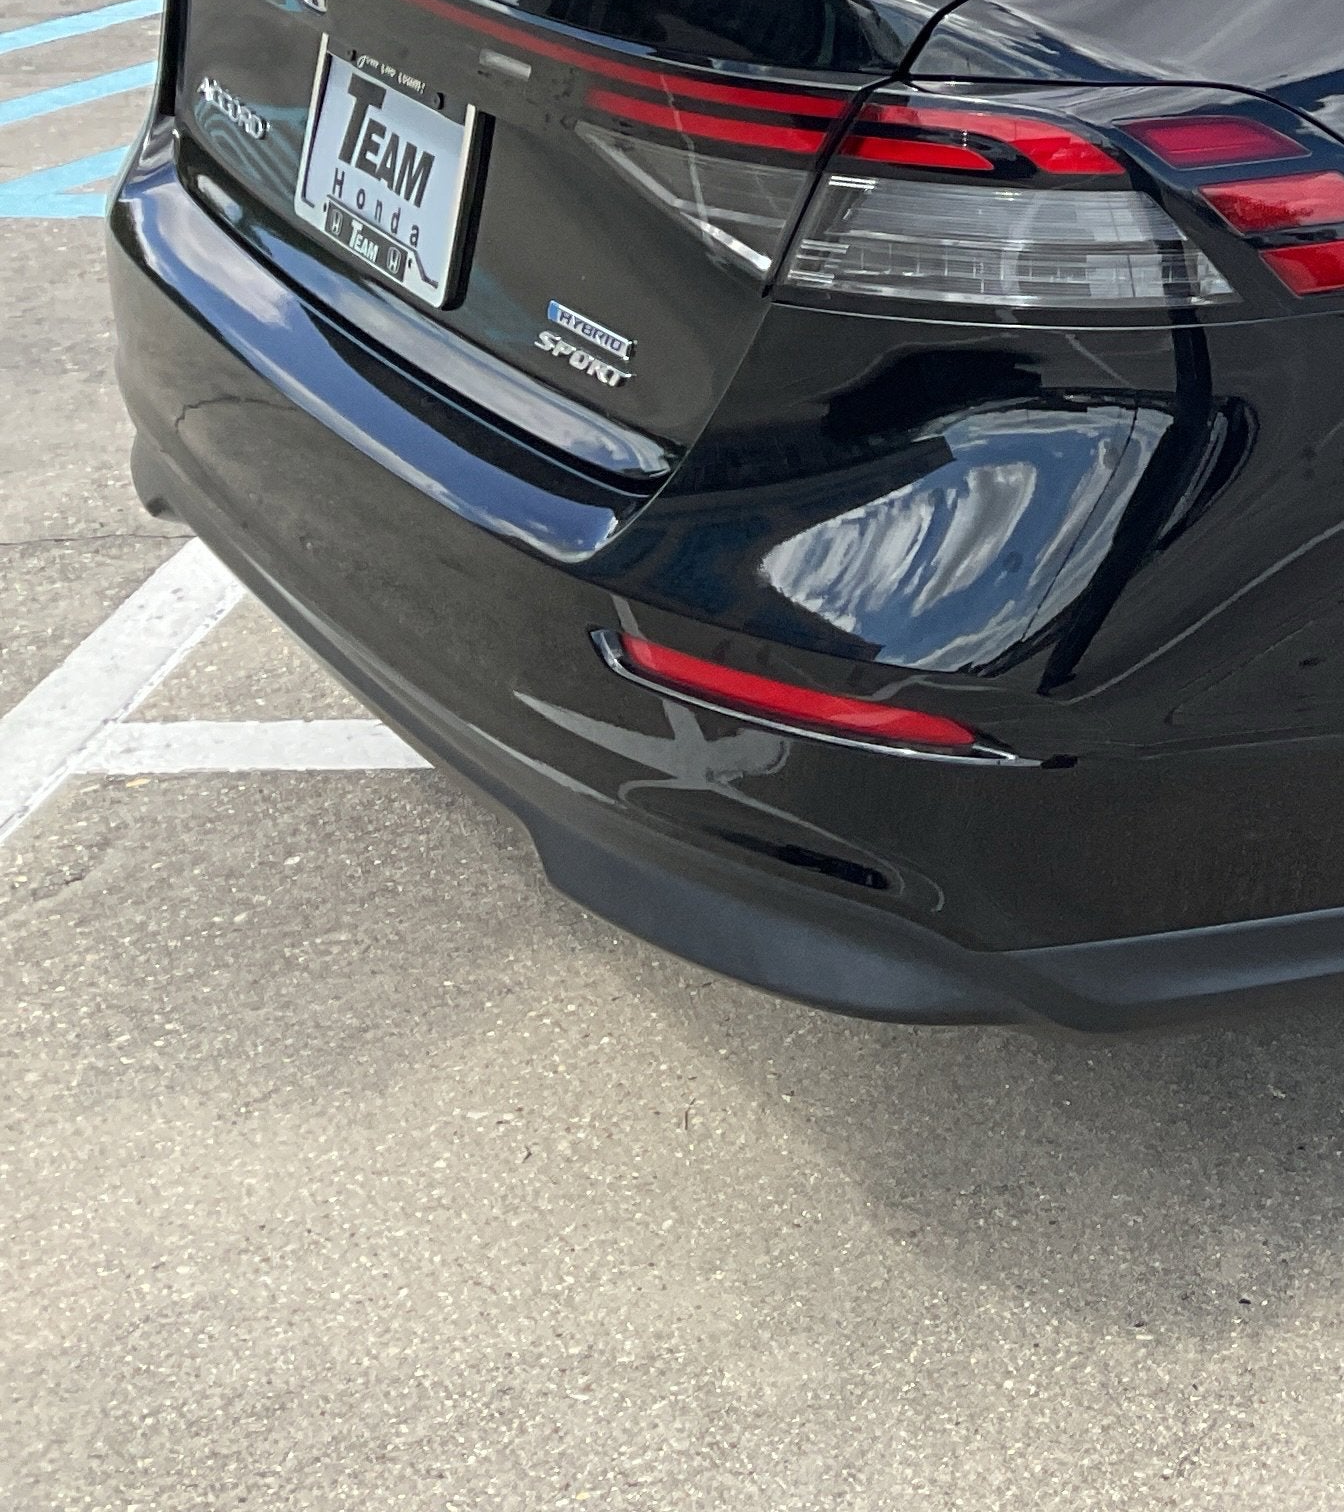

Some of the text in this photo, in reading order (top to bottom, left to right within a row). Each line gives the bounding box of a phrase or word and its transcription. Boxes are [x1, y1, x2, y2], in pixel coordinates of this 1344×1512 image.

[338, 72, 436, 209] TEAM
[332, 167, 420, 248] Honda
[349, 218, 380, 263] TEAM
[534, 330, 632, 387] SPORT
[558, 310, 622, 352] HYBRID
